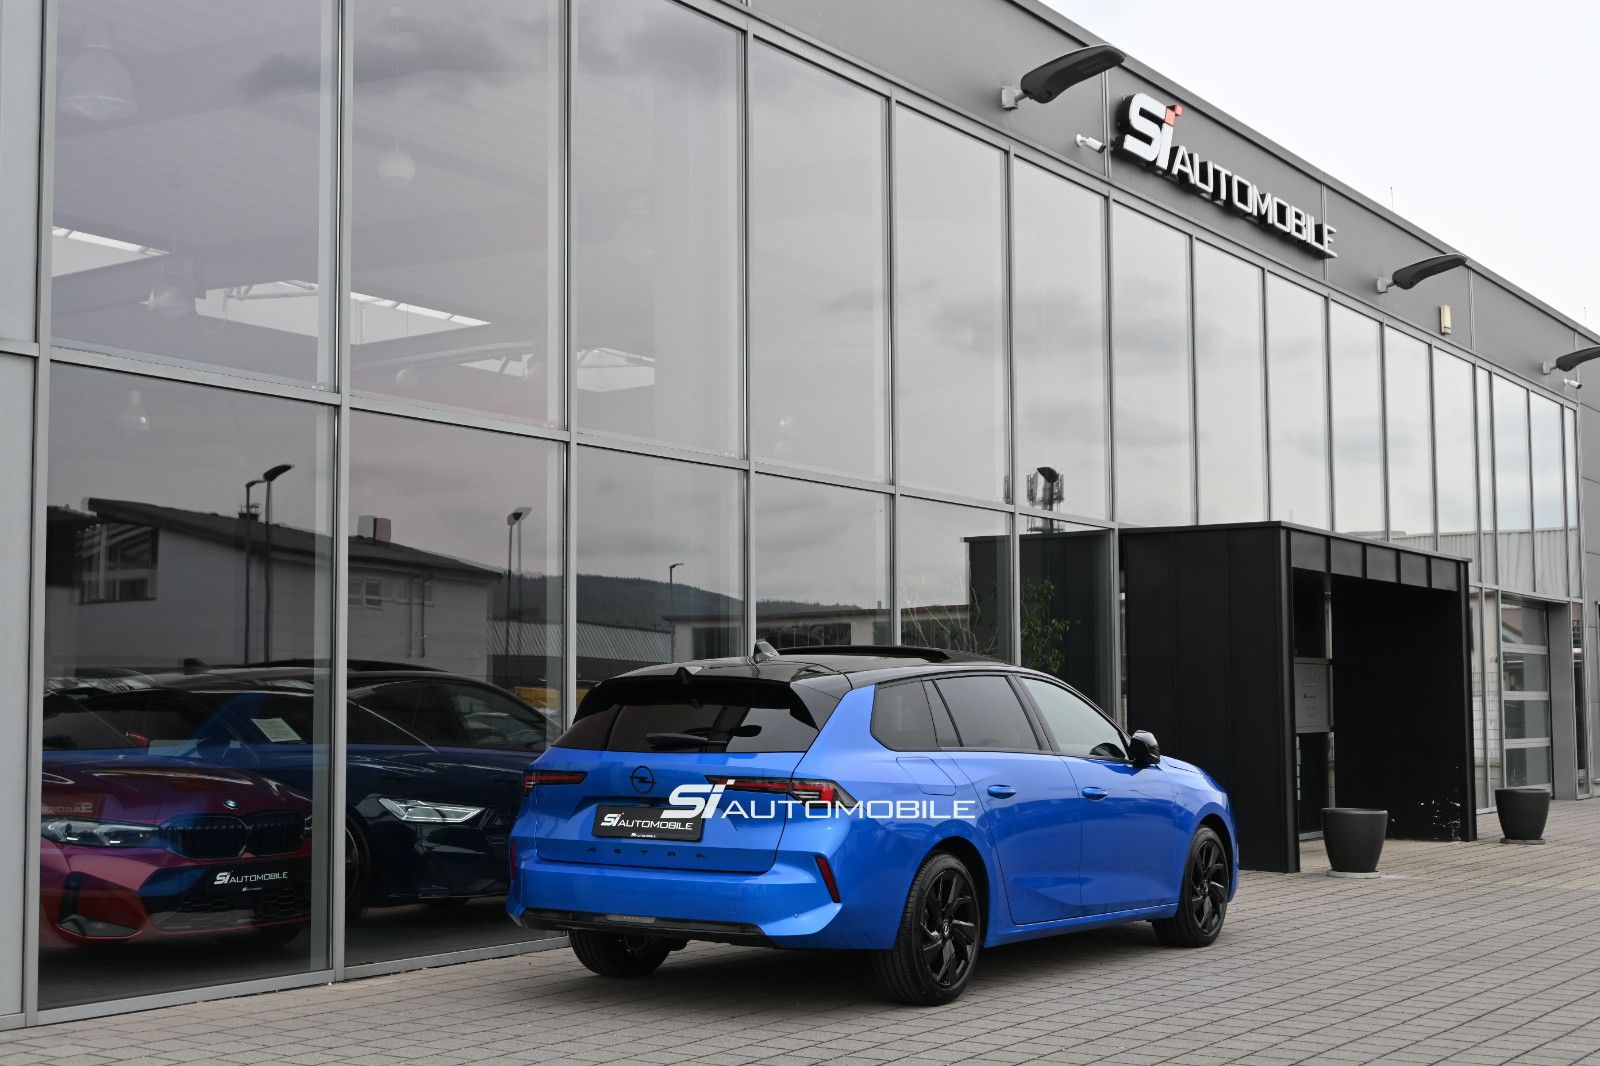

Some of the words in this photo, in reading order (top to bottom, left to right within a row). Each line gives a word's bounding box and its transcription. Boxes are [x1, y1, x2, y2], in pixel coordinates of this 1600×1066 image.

[1171, 145, 1338, 259] AUTOMOBILE
[618, 819, 693, 831] AUTOMOBILE
[229, 871, 288, 884] AUTOMOBILE
